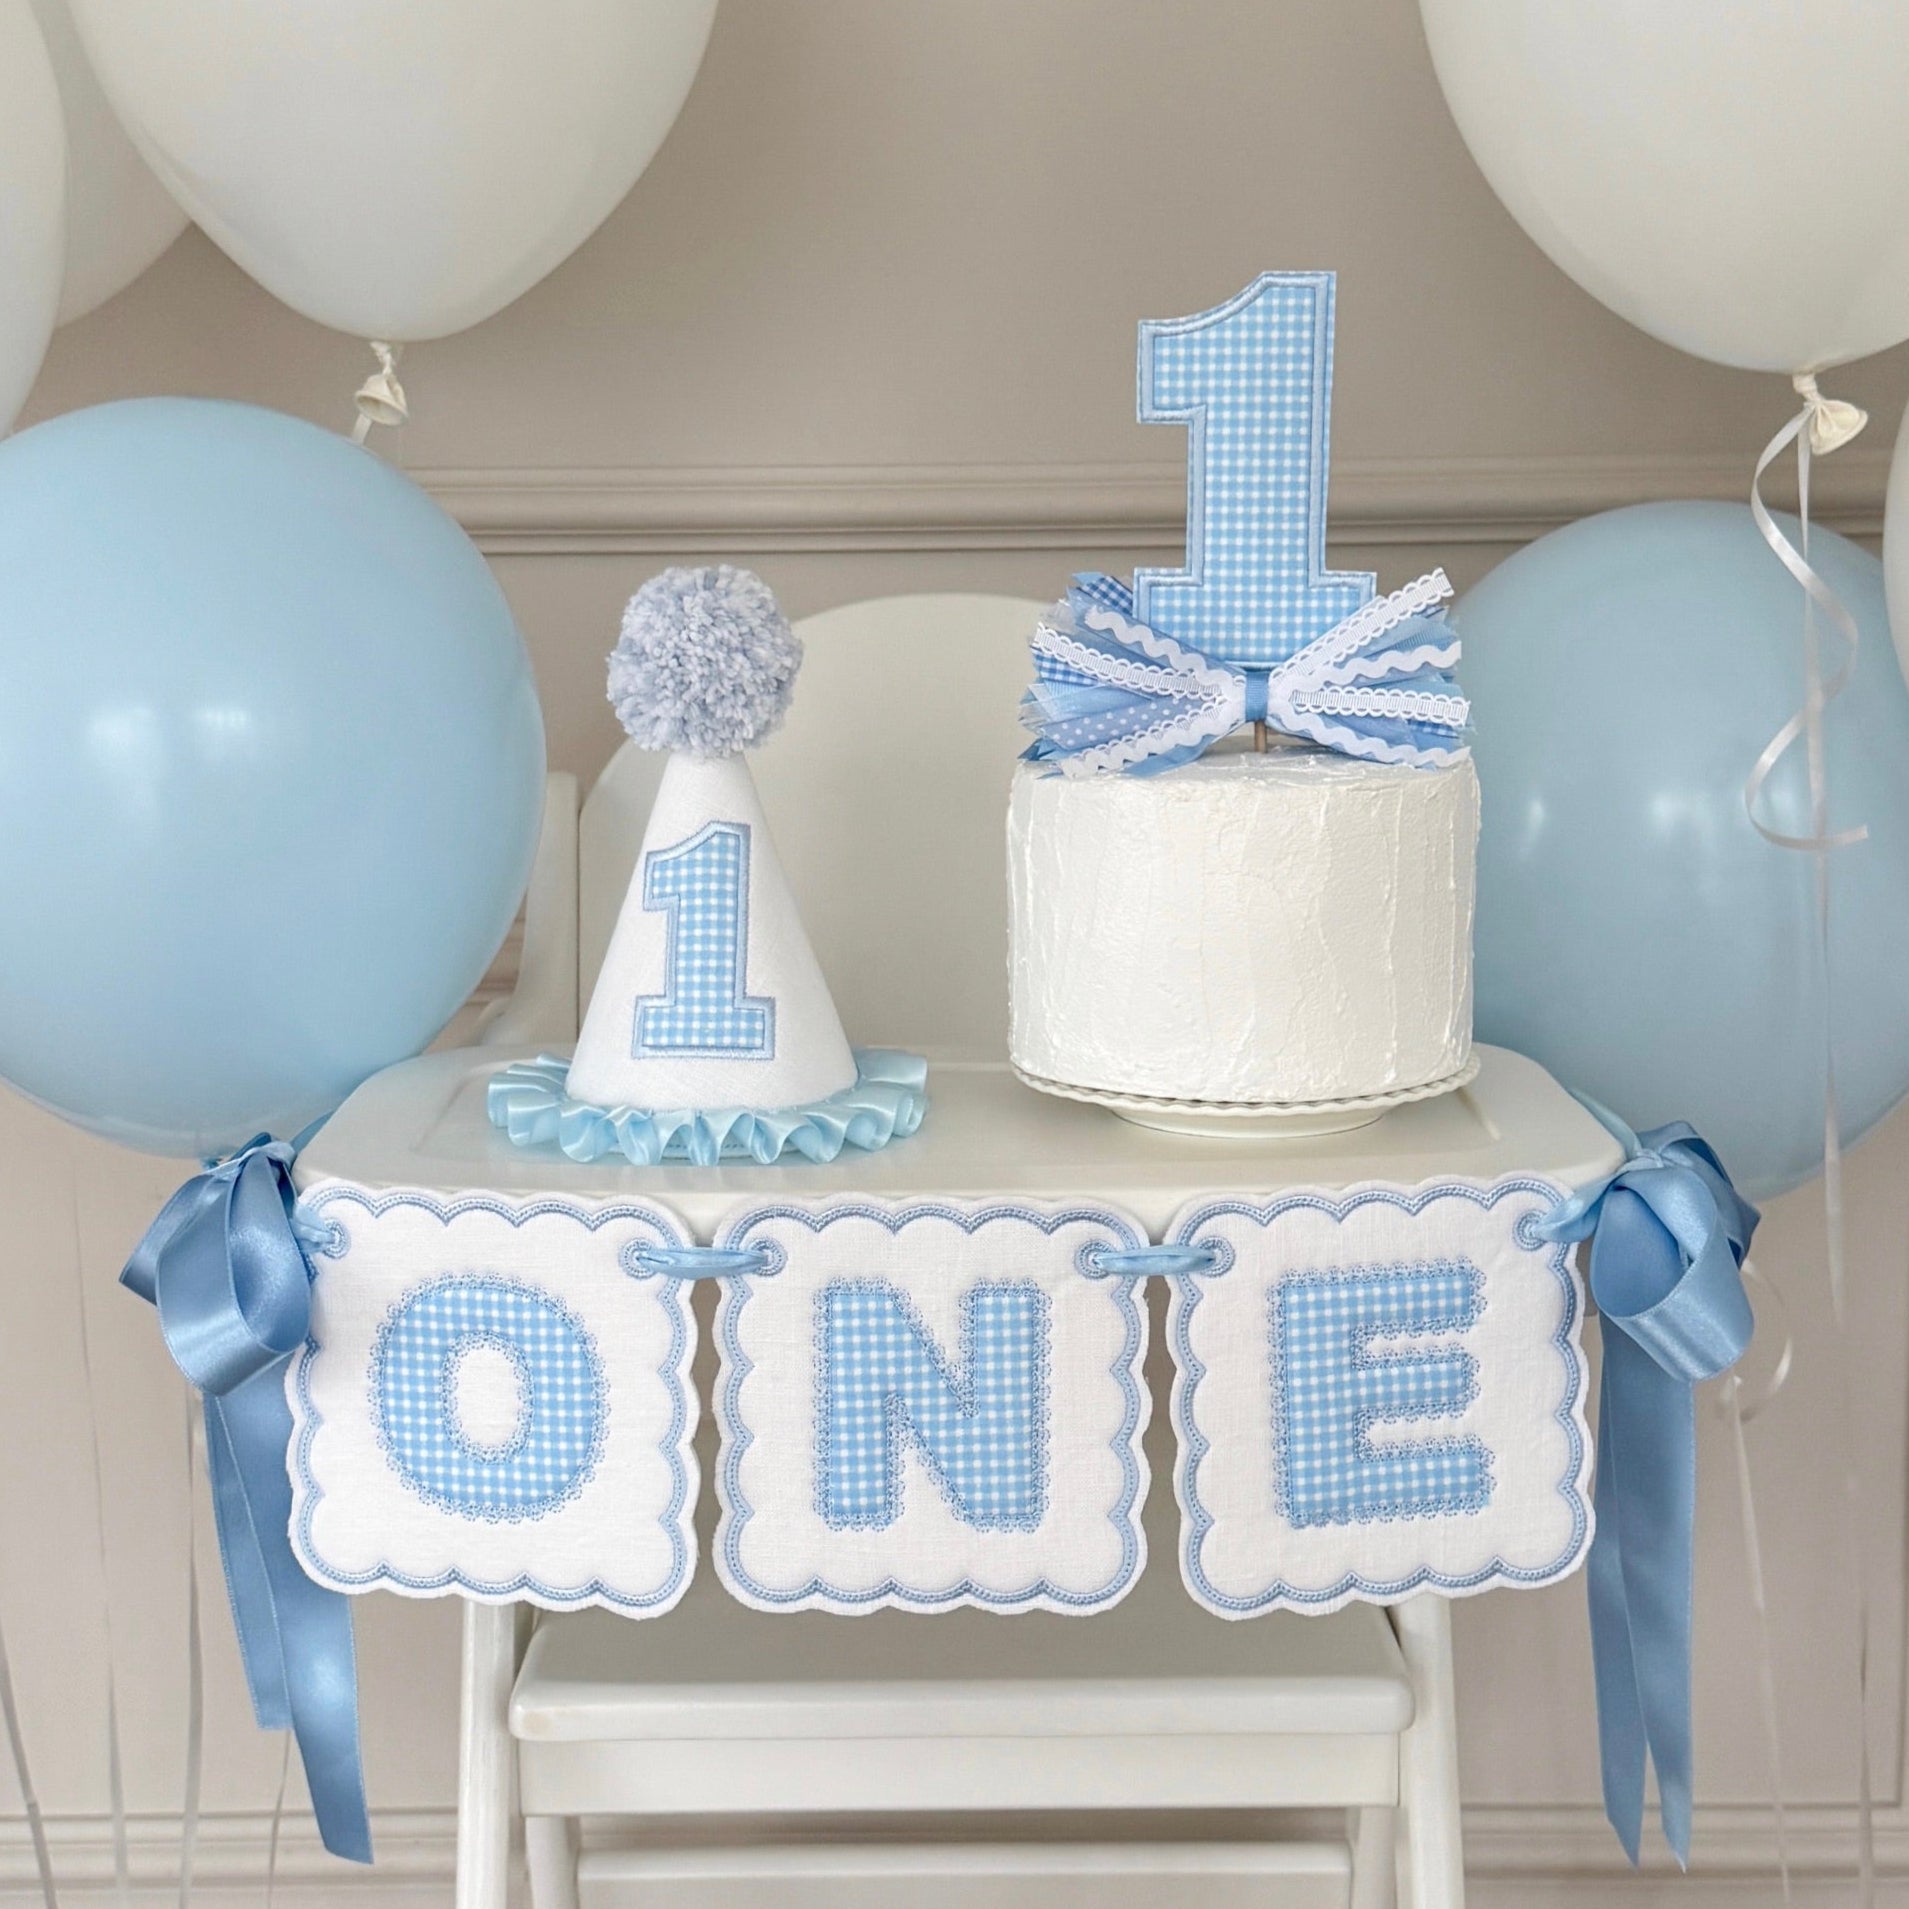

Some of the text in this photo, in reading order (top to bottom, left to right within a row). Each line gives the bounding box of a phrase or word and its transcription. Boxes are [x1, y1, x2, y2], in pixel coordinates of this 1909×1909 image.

[1136, 271, 1377, 662] 1
[633, 822, 775, 1060] 1
[368, 1258, 1494, 1534] ONE
